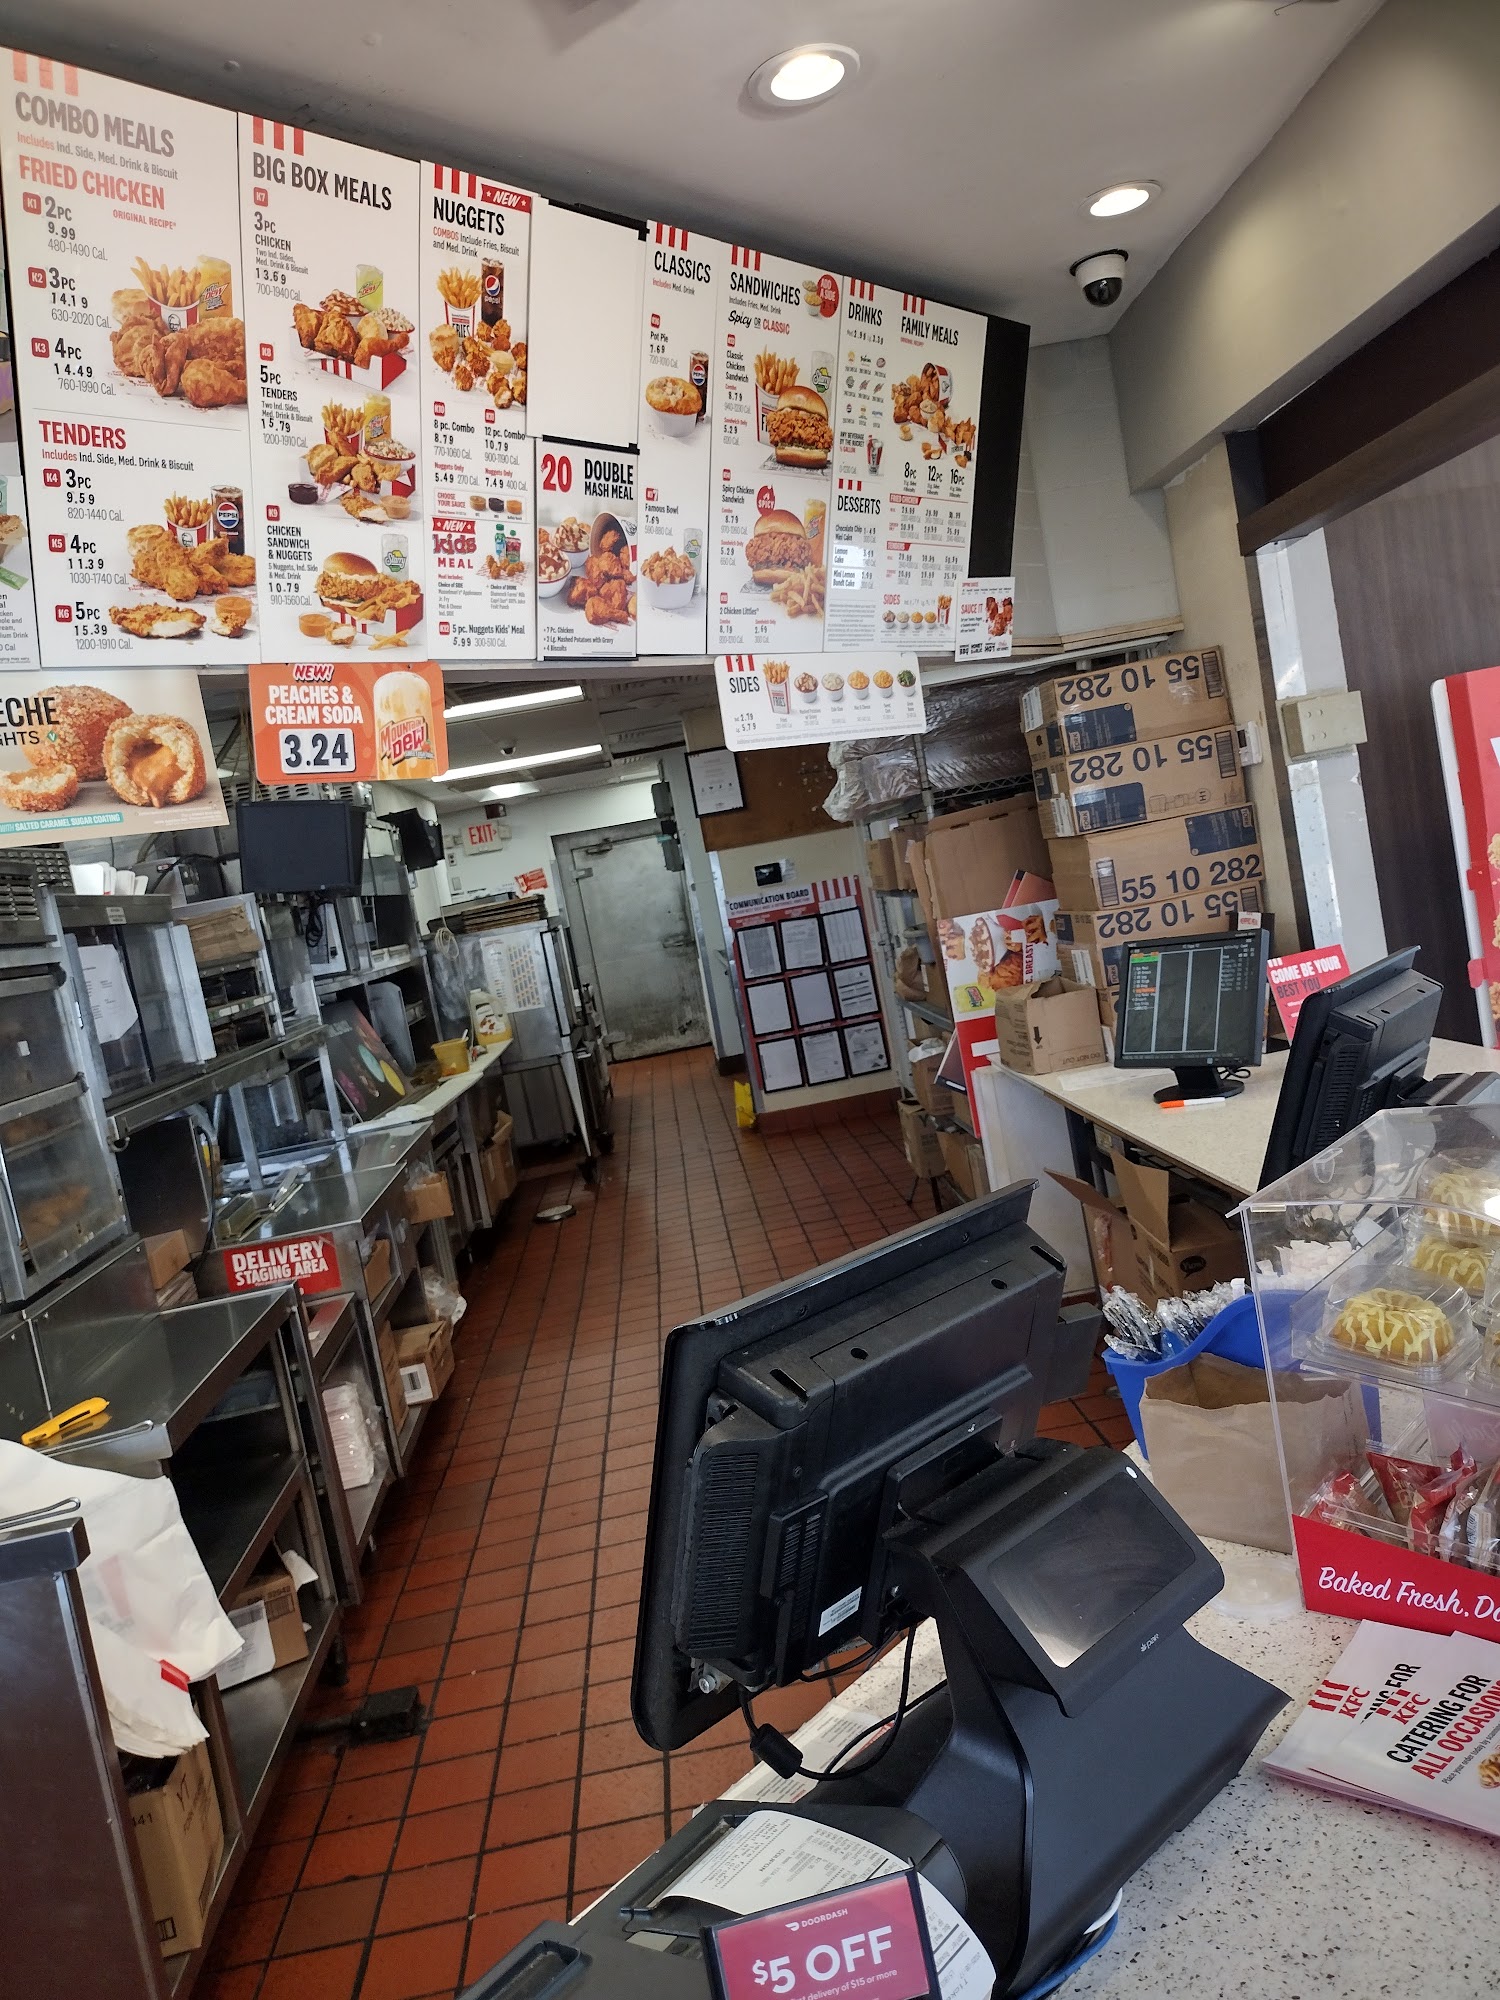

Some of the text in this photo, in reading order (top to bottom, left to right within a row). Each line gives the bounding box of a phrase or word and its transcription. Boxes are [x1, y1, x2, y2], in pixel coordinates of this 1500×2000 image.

[15, 91, 175, 157] COMBO MEALS
[17, 132, 178, 180] Includes Ind. Side, Med. Drink & Biscuit
[19, 155, 165, 210] FRIED CHICKEN
[253, 152, 392, 211] BIG BOX MEALS
[492, 190, 520, 207] NEW
[113, 209, 147, 225] ORIGINAL
[433, 196, 504, 236] NUGGETS
[48, 222, 76, 241] 9.99
[433, 226, 519, 256] COMBOS Include Fries, Biscuit
[255, 234, 291, 251] CHICKEN
[433, 240, 478, 257] and Med. Drink
[256, 267, 286, 285] 13.69
[654, 251, 711, 283] CLASSICS
[730, 272, 800, 306] SANDWICHES
[728, 310, 790, 335] Spicy CLASSIC
[848, 302, 882, 326] DRINKS
[901, 316, 959, 346] FAMILY MEALS
[727, 350, 744, 361] Classic
[54, 363, 93, 378] 14.49
[726, 361, 746, 372] Chicken
[726, 372, 749, 383] Sandwich
[261, 387, 298, 401] TENDERS
[39, 420, 127, 450] TENDERS
[452, 421, 474, 433] Combo
[504, 429, 525, 440] Combo
[435, 433, 453, 445] 8.79
[485, 439, 508, 451] 10.79
[42, 449, 194, 471] Includes Ind. Side, Med. Drink & Biscuit
[435, 473, 453, 483] 5.49
[541, 454, 572, 492] 20
[585, 459, 633, 485] DOUBLE
[66, 491, 95, 505] 9.59
[585, 481, 633, 500] MASH MEAL
[645, 503, 679, 515] Famous Bowl
[757, 501, 775, 509] SPICY
[838, 495, 880, 515] DESSERTS
[267, 525, 301, 537] CHICKEN
[443, 521, 466, 532] NEW
[268, 538, 310, 549] SANDWICH
[432, 534, 477, 555] kids
[69, 558, 104, 570] 11.39
[269, 550, 313, 561] & NUGGETS
[438, 558, 474, 569] MEAL
[269, 582, 300, 593] 10.79
[883, 594, 900, 605] SIDES
[961, 603, 978, 615] SAUCE
[74, 625, 108, 636] 15.39
[469, 624, 494, 635] Nuggets
[512, 625, 525, 634] Meal
[453, 637, 471, 646] 5.99
[294, 664, 334, 681] NEW!
[1058, 655, 1200, 705] 55 10 282
[729, 676, 760, 694] SIDES
[268, 686, 353, 704] PEACHES &
[265, 706, 364, 724] CREAM SODA
[285, 733, 348, 768] 3.24
[1069, 735, 1213, 784] 55 10 282
[15, 813, 121, 831] SALTED CARAMEL SUGAR COATING
[468, 824, 493, 846] EXIT
[1121, 853, 1263, 903] 55 10 282
[730, 893, 784, 910] COMMUNICATION
[786, 889, 809, 899] BOARD
[1097, 890, 1238, 939] 55 10 282
[1026, 943, 1034, 975] BREAST
[1270, 955, 1341, 984] COME BE YOUR
[1276, 977, 1320, 998] BEST YOU
[232, 1239, 325, 1273] DELIVERY
[235, 1264, 291, 1287] STAGING
[294, 1257, 329, 1276] AREA
[1318, 1566, 1470, 1618] Baked Fresh.
[1338, 1686, 1370, 1719] KFC
[1391, 1693, 1431, 1725] KFC
[1386, 1674, 1492, 1763] CATERING FOR
[1411, 1751, 1455, 1780] ALL
[801, 1908, 848, 1928] DOORDASH
[752, 1925, 892, 1993] $5 OFF
[808, 1987, 840, 2000] delivery
[841, 1983, 849, 1991] of
[851, 1977, 865, 1989] $15
[875, 1969, 897, 1981] more
